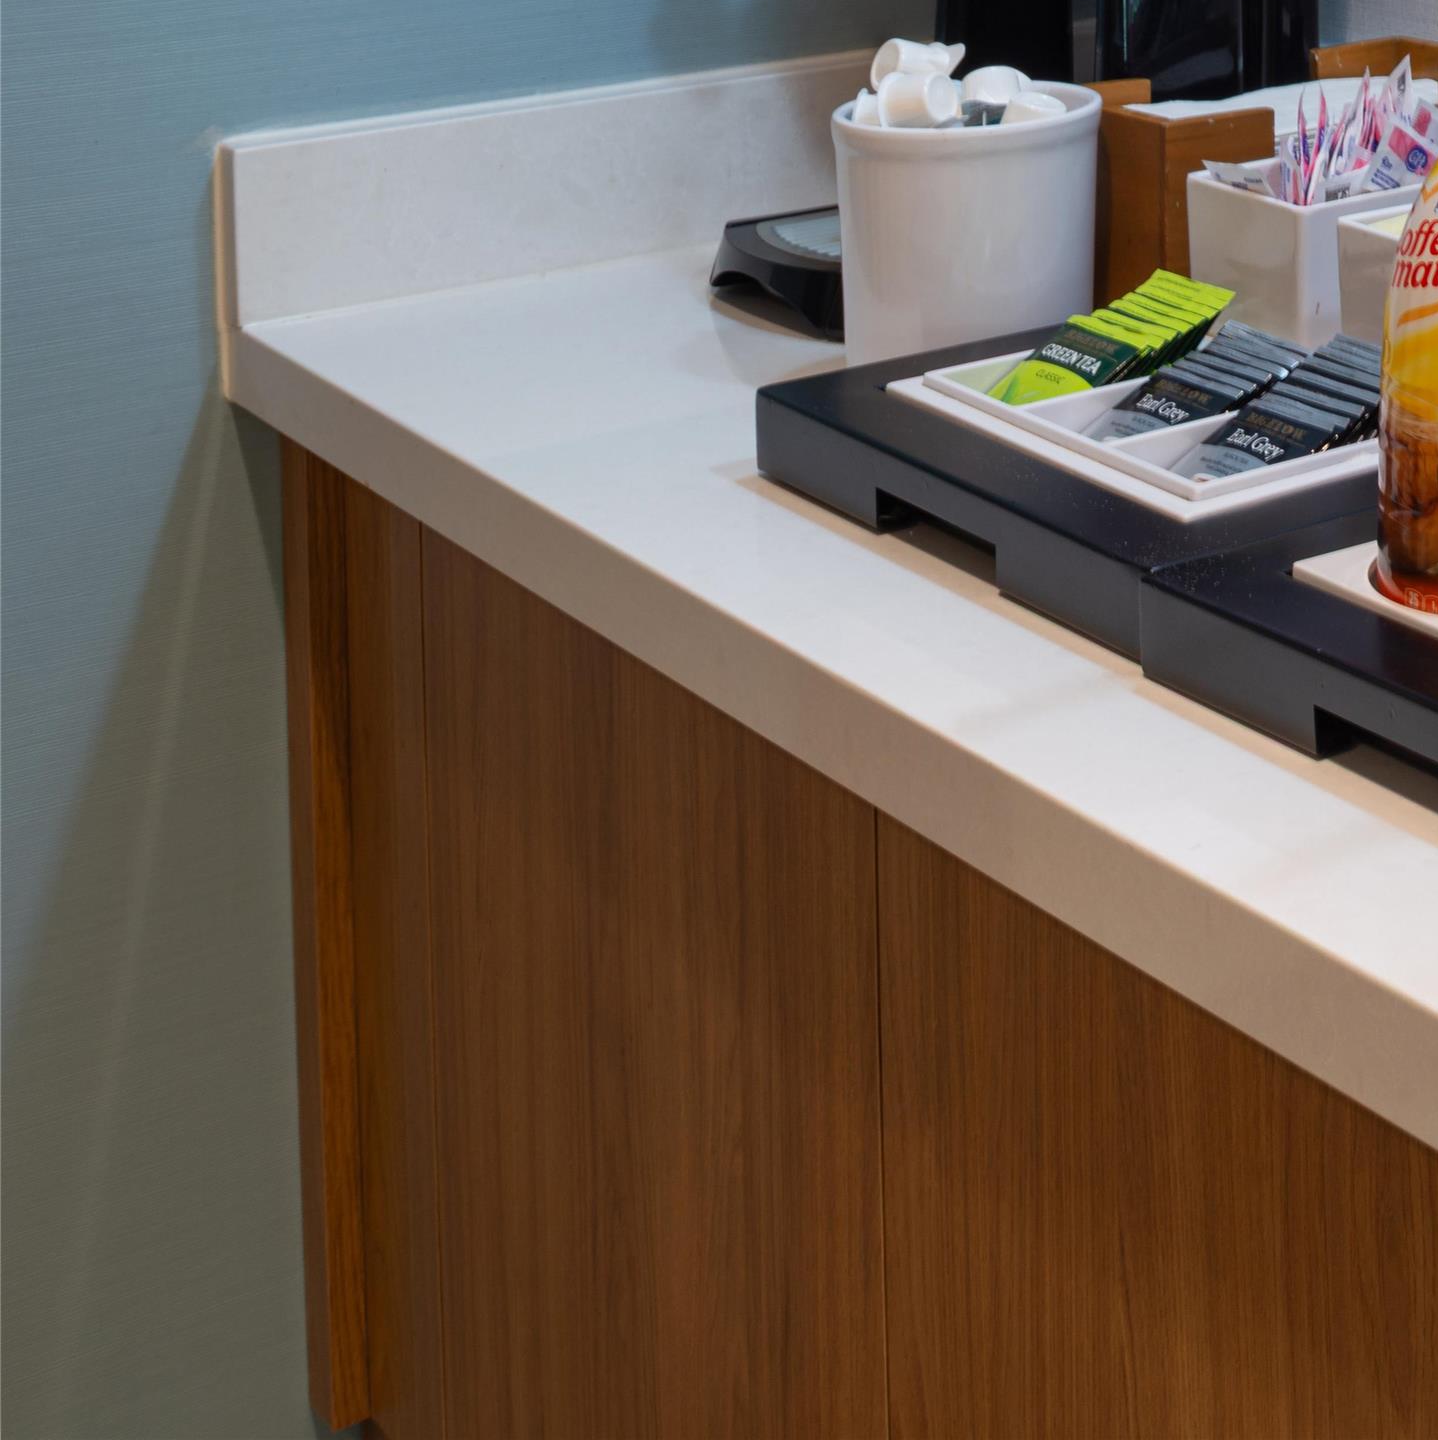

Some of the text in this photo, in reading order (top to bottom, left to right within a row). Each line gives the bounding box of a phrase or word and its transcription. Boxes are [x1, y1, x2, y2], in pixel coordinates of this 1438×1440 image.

[1041, 343, 1103, 376] GREEN TEA
[1135, 393, 1167, 413] Earl
[1158, 401, 1191, 426] Grey
[1226, 427, 1259, 449] Earl
[1250, 436, 1286, 463] Grey
